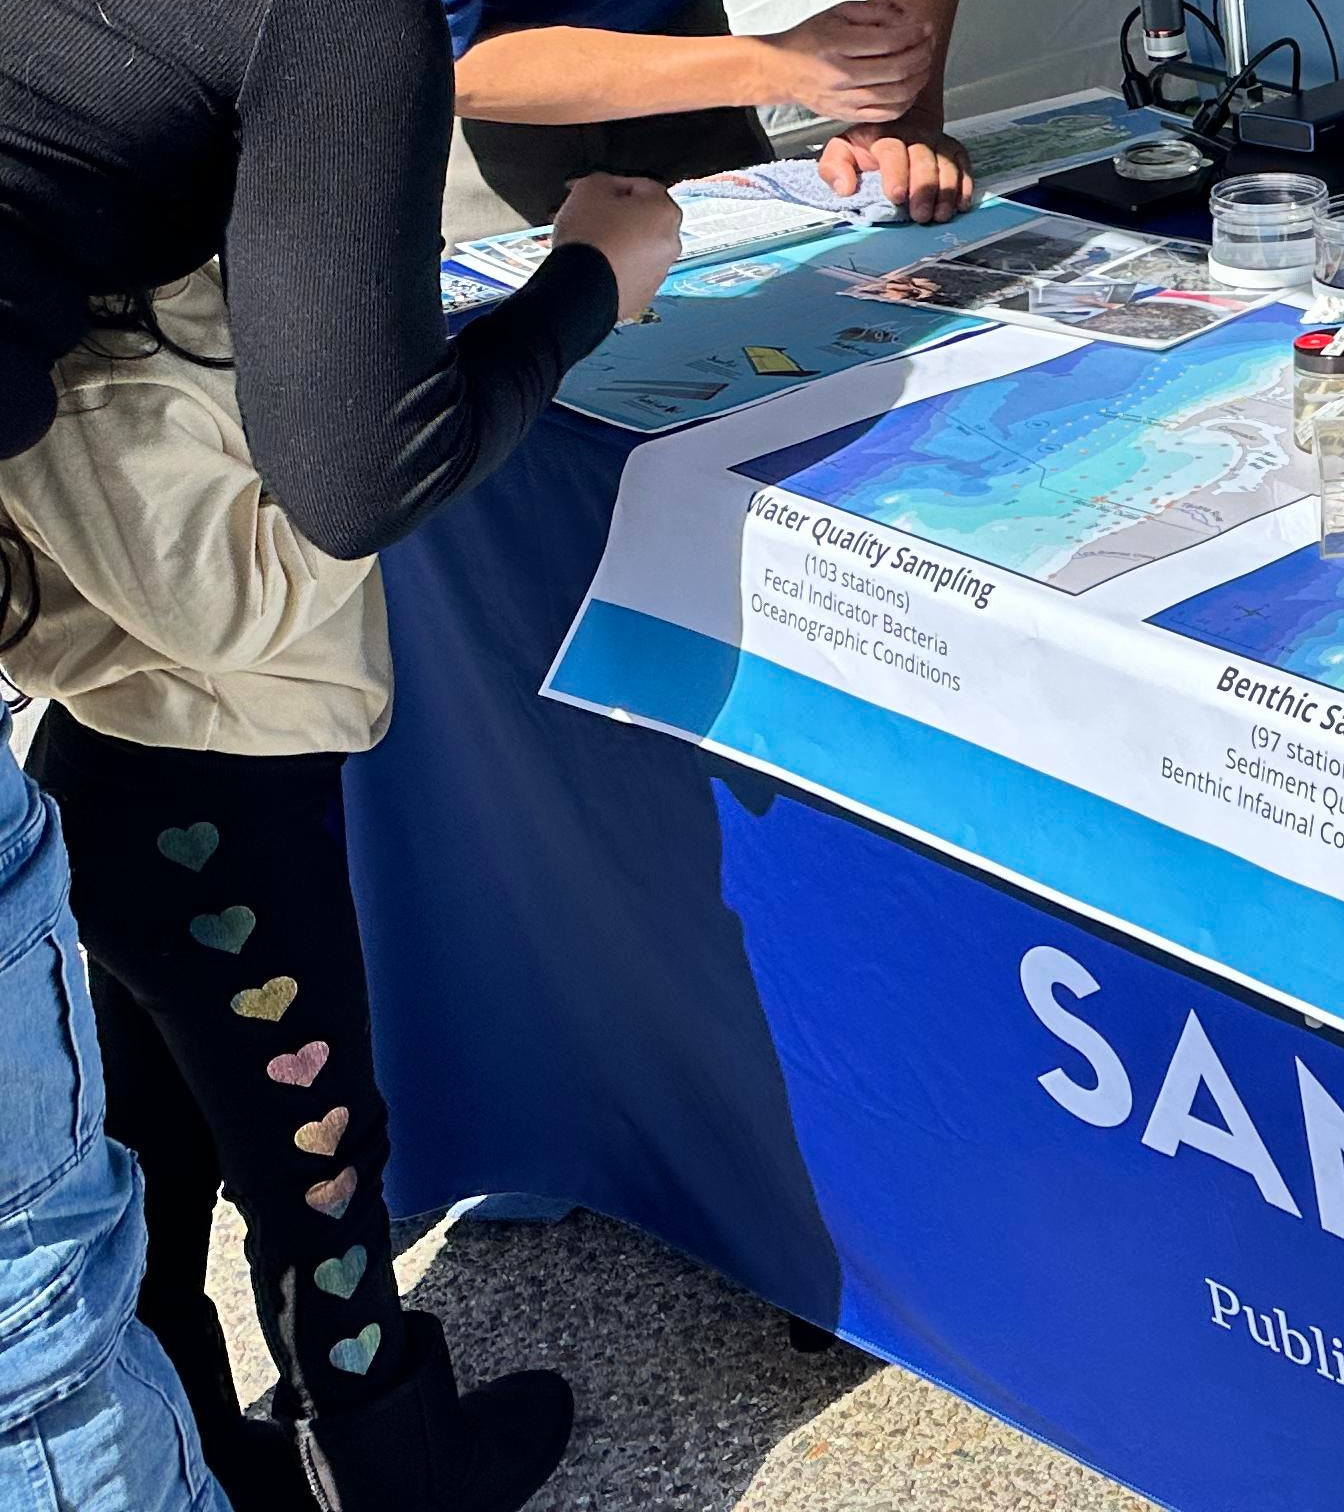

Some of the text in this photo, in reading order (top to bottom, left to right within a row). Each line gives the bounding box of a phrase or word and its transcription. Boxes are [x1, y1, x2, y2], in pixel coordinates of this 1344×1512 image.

[747, 491, 996, 609] Water Quality Sampling
[804, 552, 910, 614] (103 stations)
[751, 593, 960, 692] Oceanographic Conditions
[764, 569, 948, 657] Fecal Indicator Bacteria
[1216, 665, 1318, 723] Benthic
[1250, 723, 1280, 752] (97
[1161, 756, 1232, 804] Benthic
[1238, 784, 1314, 838] Infaunal
[1225, 748, 1317, 804] Sediment
